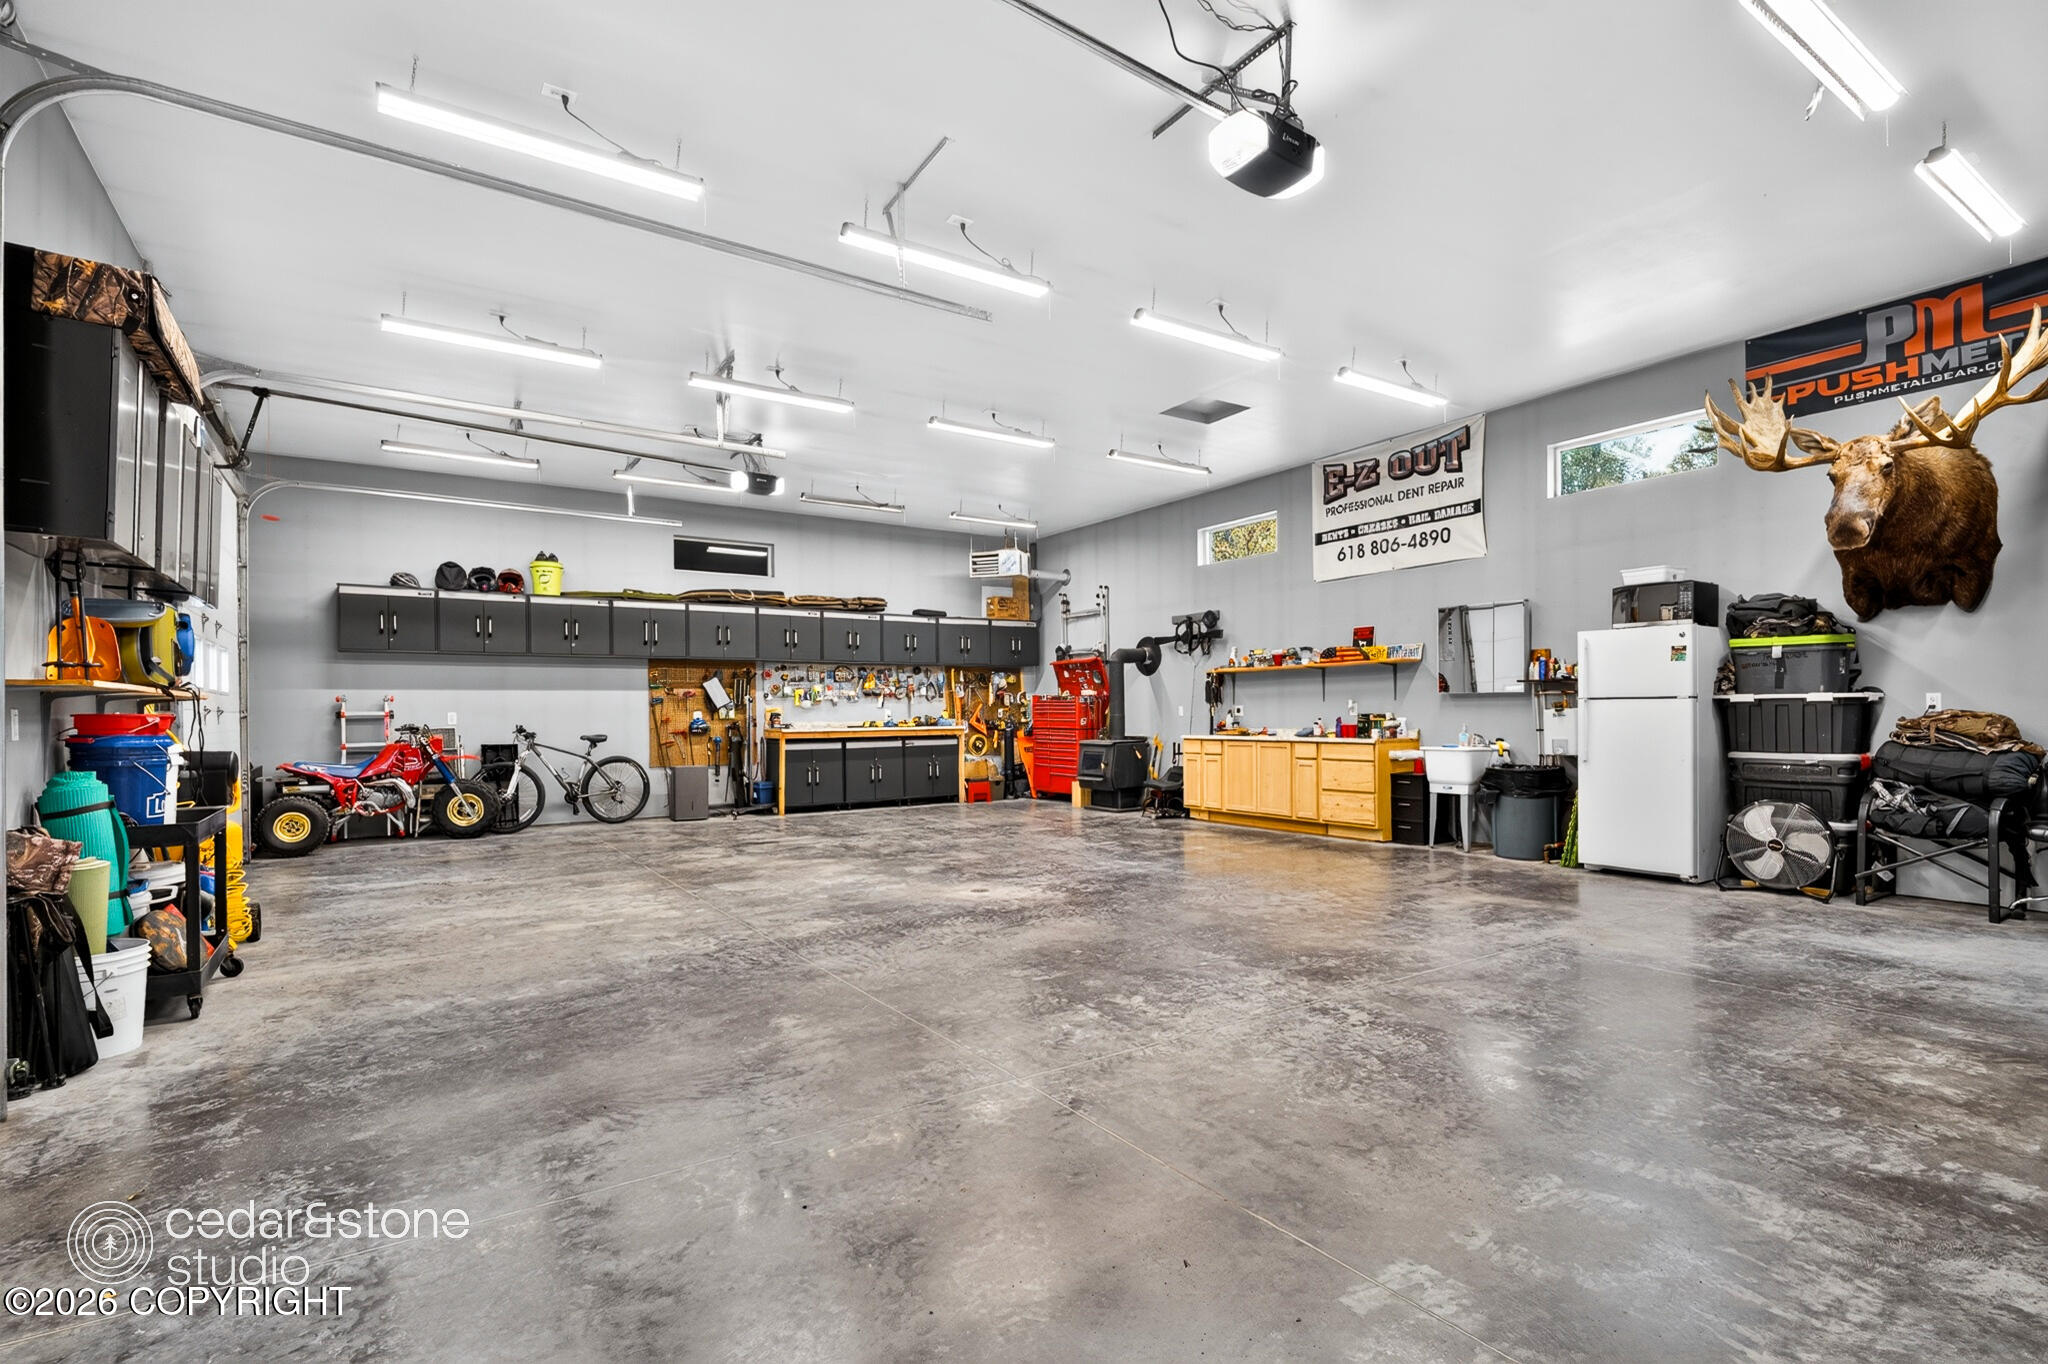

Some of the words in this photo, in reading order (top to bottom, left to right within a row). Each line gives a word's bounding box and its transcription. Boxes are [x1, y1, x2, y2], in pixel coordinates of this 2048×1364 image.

[1864, 282, 1985, 365] PM
[1787, 332, 2025, 405] PUSHMET
[1323, 458, 1380, 505] E-Z
[1388, 424, 1470, 480] OUT
[1325, 493, 1394, 517] PROFESSIONAL
[1397, 486, 1424, 501] DENT
[1428, 477, 1464, 494] REPAIR
[1408, 512, 1431, 525] HAIL
[1337, 543, 1365, 562] 618
[1370, 527, 1451, 556] 806-4890
